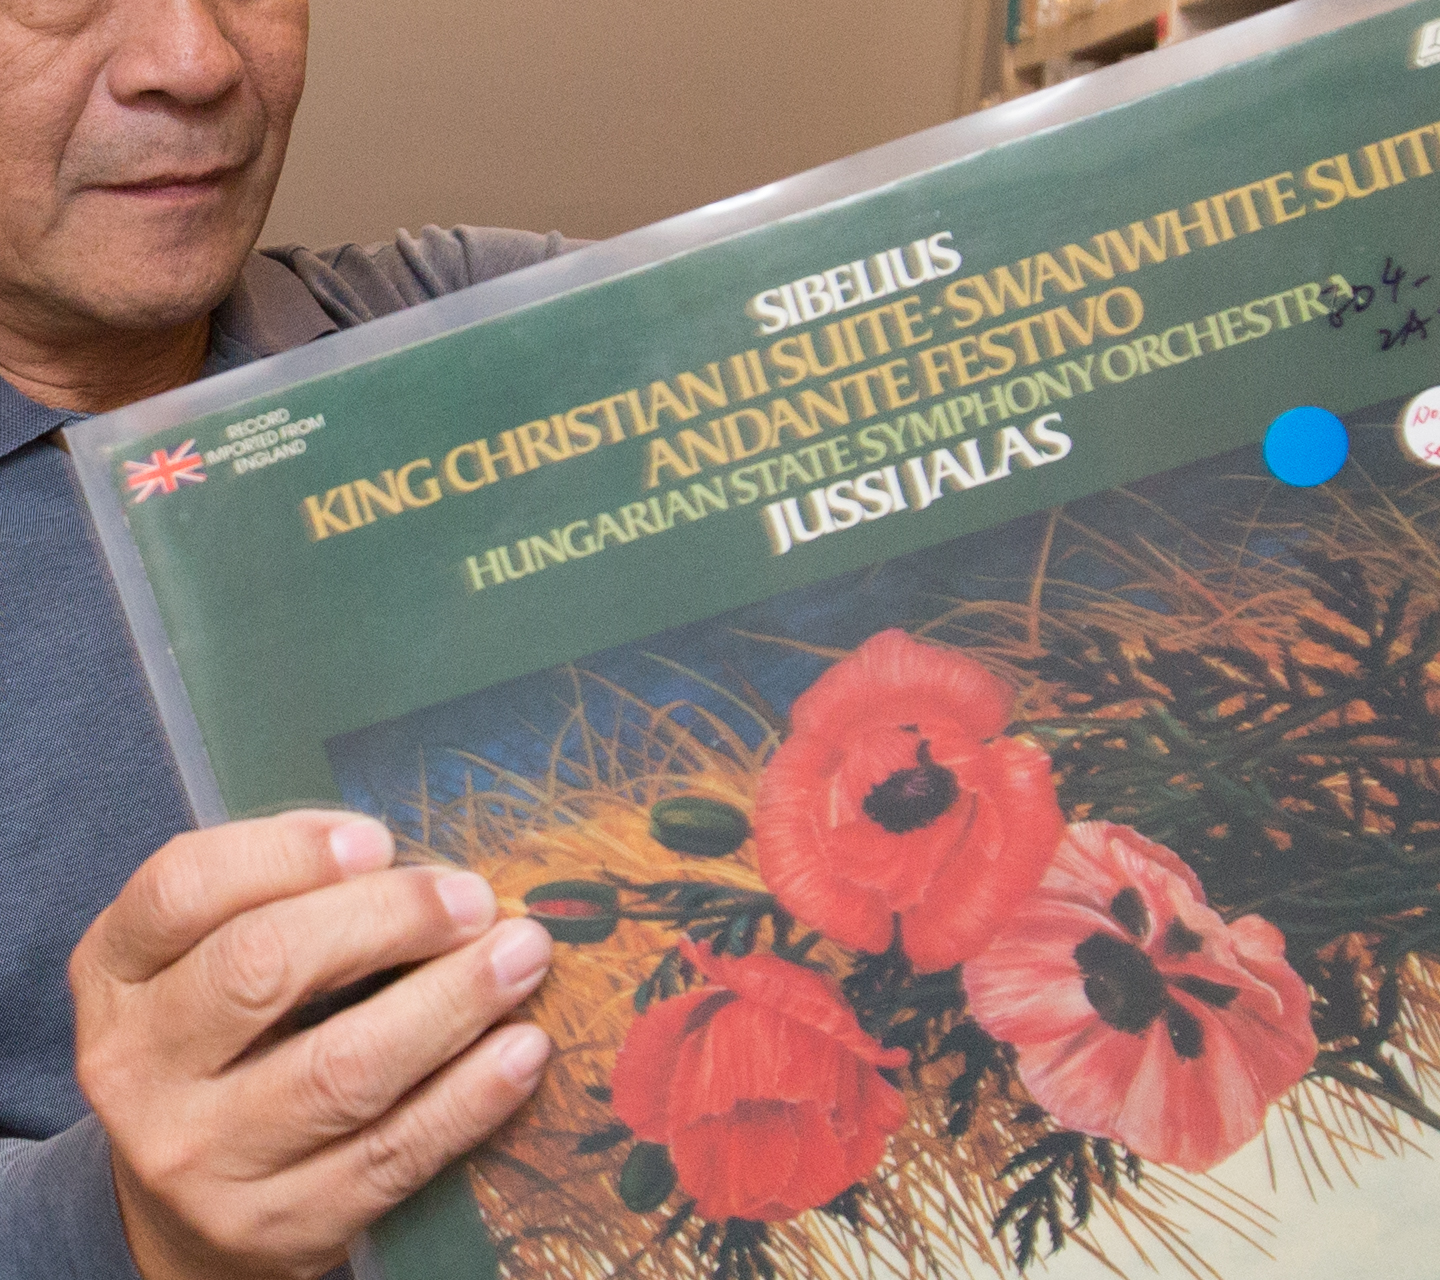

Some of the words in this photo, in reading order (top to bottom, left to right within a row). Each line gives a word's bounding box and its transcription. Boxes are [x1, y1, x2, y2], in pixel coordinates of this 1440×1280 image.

[751, 231, 963, 336] SIBELIUS
[301, 458, 443, 541] KING
[445, 362, 728, 495] CHRISTIAN
[728, 348, 769, 400] II
[767, 293, 931, 385] SUITE
[938, 171, 1304, 332] SWANWHITE
[646, 363, 921, 488] ANDANTE
[920, 285, 1146, 396] FESTIVO
[203, 429, 279, 465] IMPORTED
[278, 413, 326, 440] FROM
[225, 408, 290, 440] RECORD
[233, 438, 307, 474] ENGLAND
[465, 476, 729, 592] HUNGARIAN
[728, 432, 858, 506] STATE
[856, 355, 1099, 463] SYMPHONY
[1098, 272, 1355, 385] ORCHESTRA
[762, 469, 912, 556] JUSSI
[911, 413, 1073, 510] JALAS
